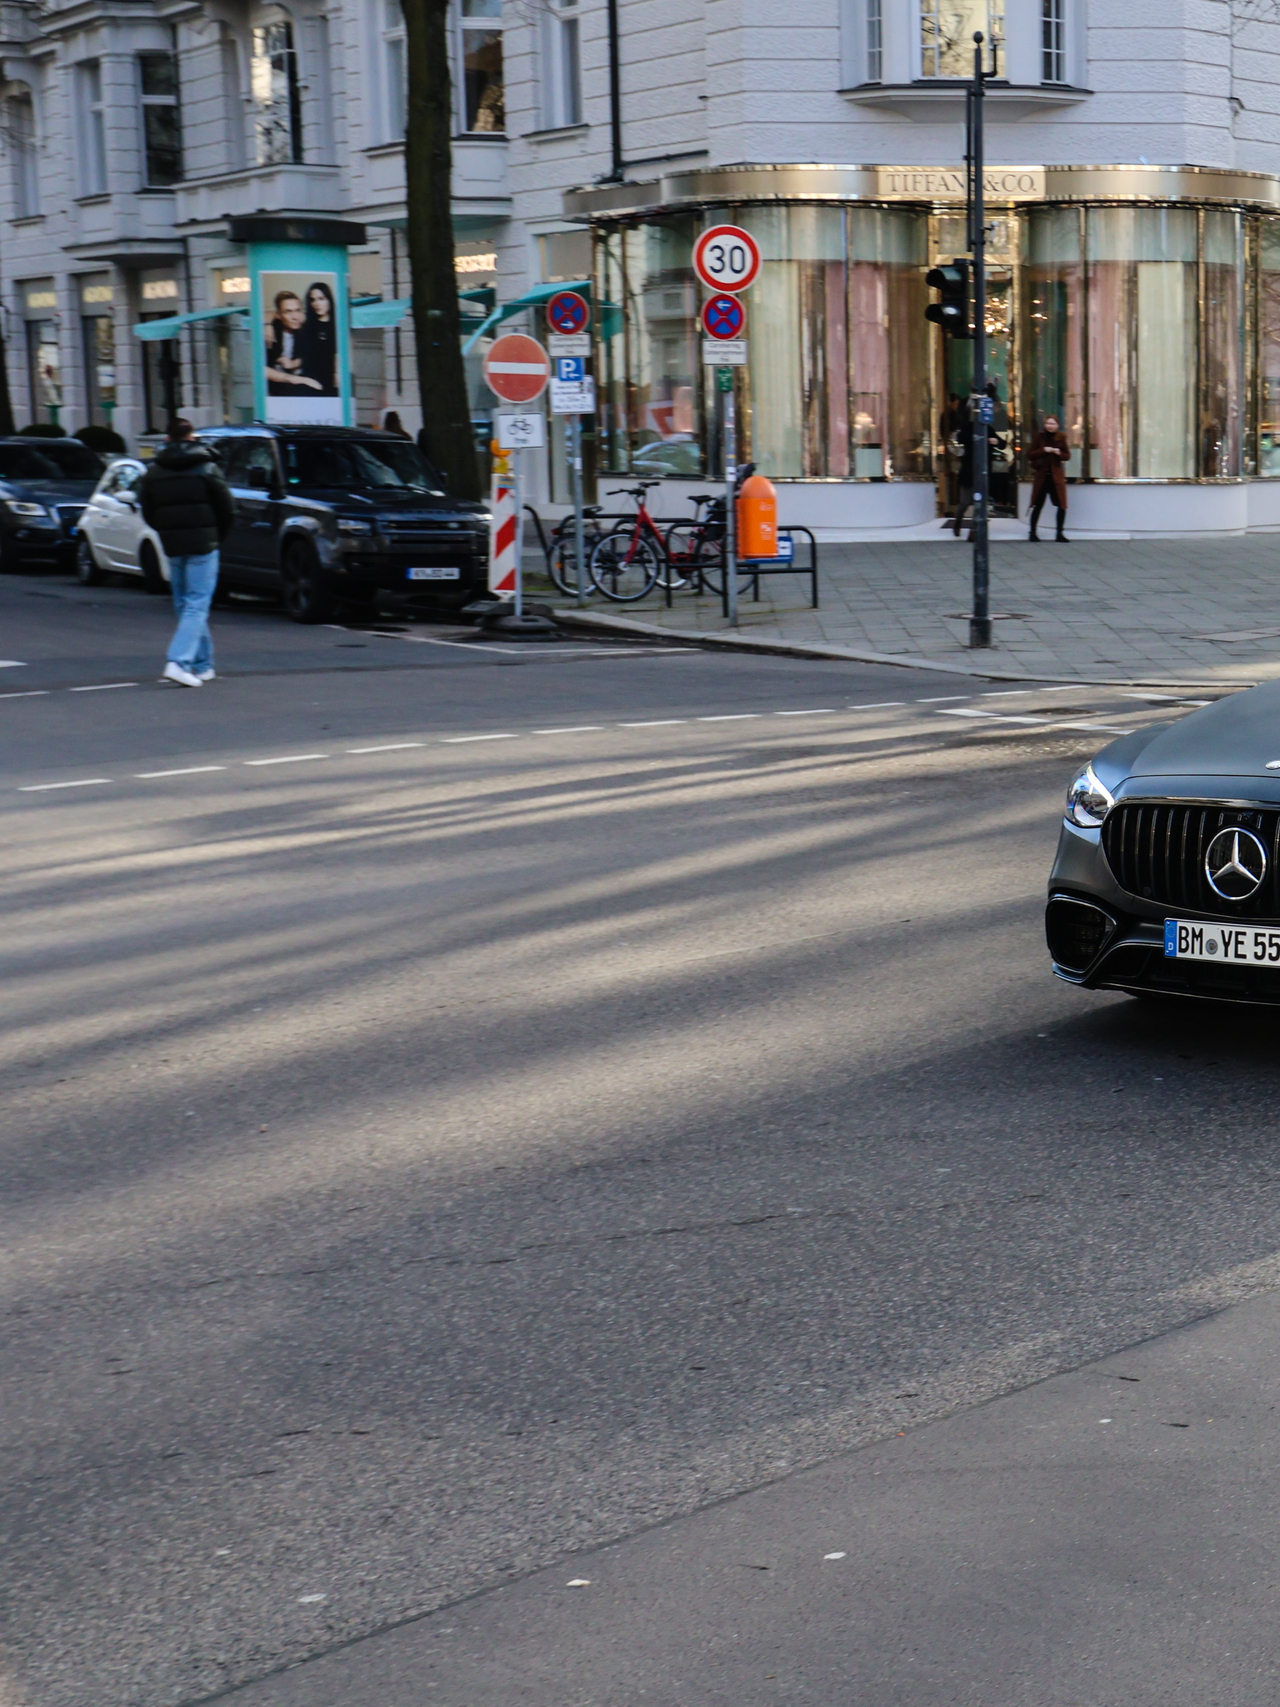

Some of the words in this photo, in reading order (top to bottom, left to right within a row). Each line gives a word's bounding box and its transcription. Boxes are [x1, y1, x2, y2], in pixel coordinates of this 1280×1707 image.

[709, 245, 745, 274] 30
[560, 359, 577, 379] P
[1168, 942, 1173, 951] D
[1178, 926, 1204, 955] BM
[1221, 930, 1247, 959] YE
